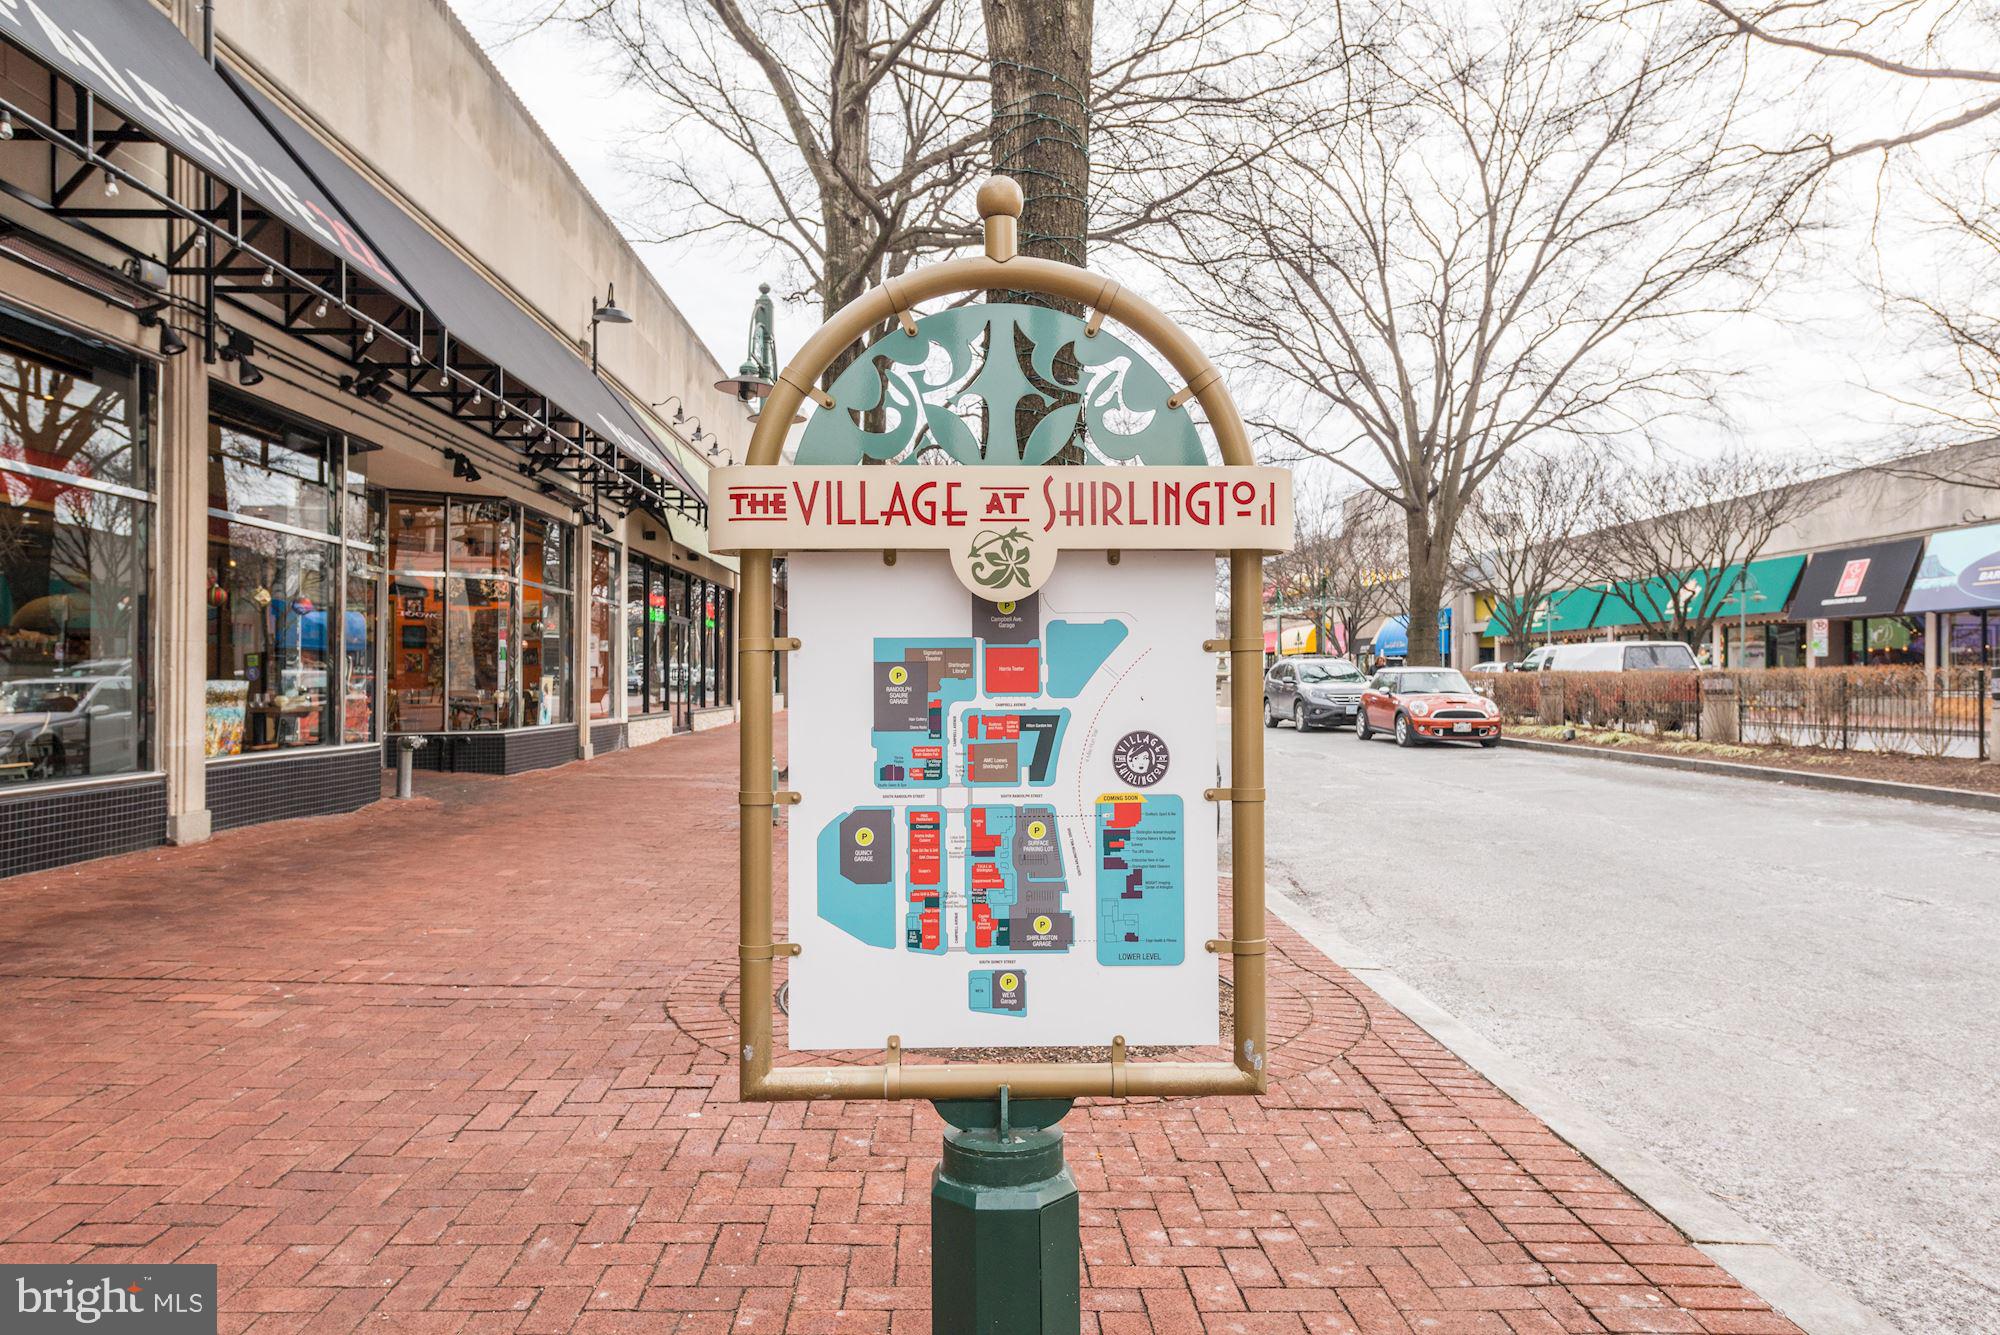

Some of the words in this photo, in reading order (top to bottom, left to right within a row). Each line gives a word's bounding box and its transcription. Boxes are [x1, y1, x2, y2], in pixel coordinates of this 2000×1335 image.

[0, 0, 340, 247] ALETTE
[728, 490, 788, 518] THE
[793, 480, 968, 527] VILLAGE
[983, 490, 1027, 518] AT
[1117, 734, 1164, 752] VILLAGE
[1116, 763, 1166, 785] SHIRLINGTON
